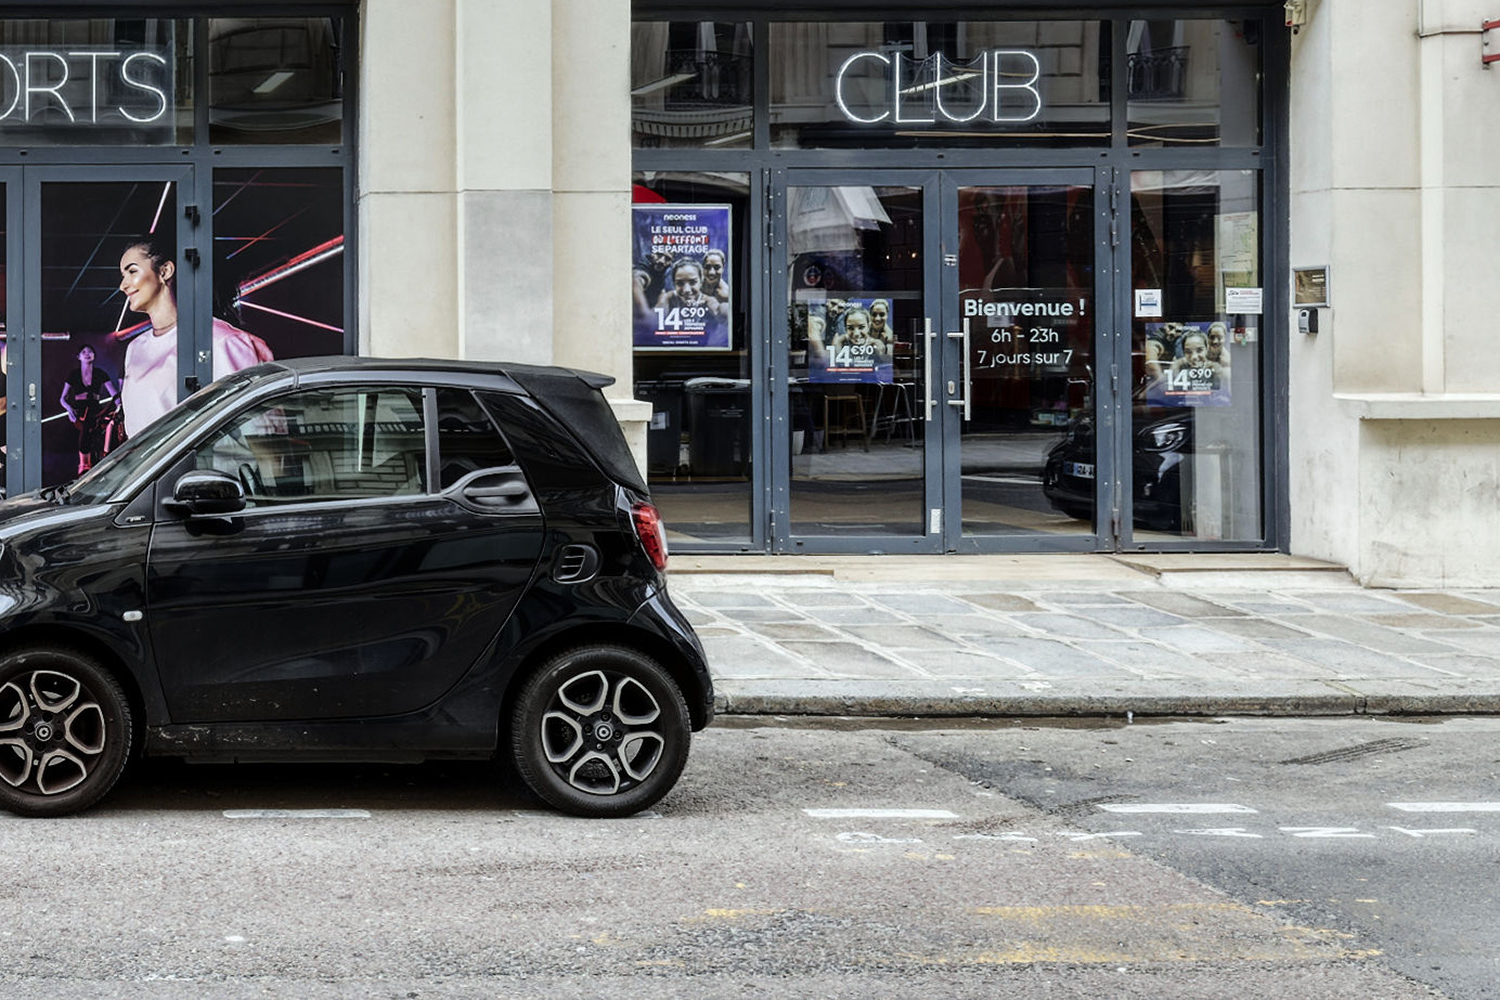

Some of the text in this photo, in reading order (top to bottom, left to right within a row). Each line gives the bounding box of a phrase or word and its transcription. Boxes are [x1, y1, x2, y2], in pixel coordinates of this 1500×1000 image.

[836, 51, 1042, 123] CLUB
[651, 226, 708, 234] LE SEUL CLUB
[651, 245, 709, 253] SE PARTAGE
[964, 298, 1085, 316] Bienvenue !
[991, 328, 1011, 343] 6h
[1029, 328, 1059, 343] 23h
[977, 349, 1073, 368] 7 jours sur 7
